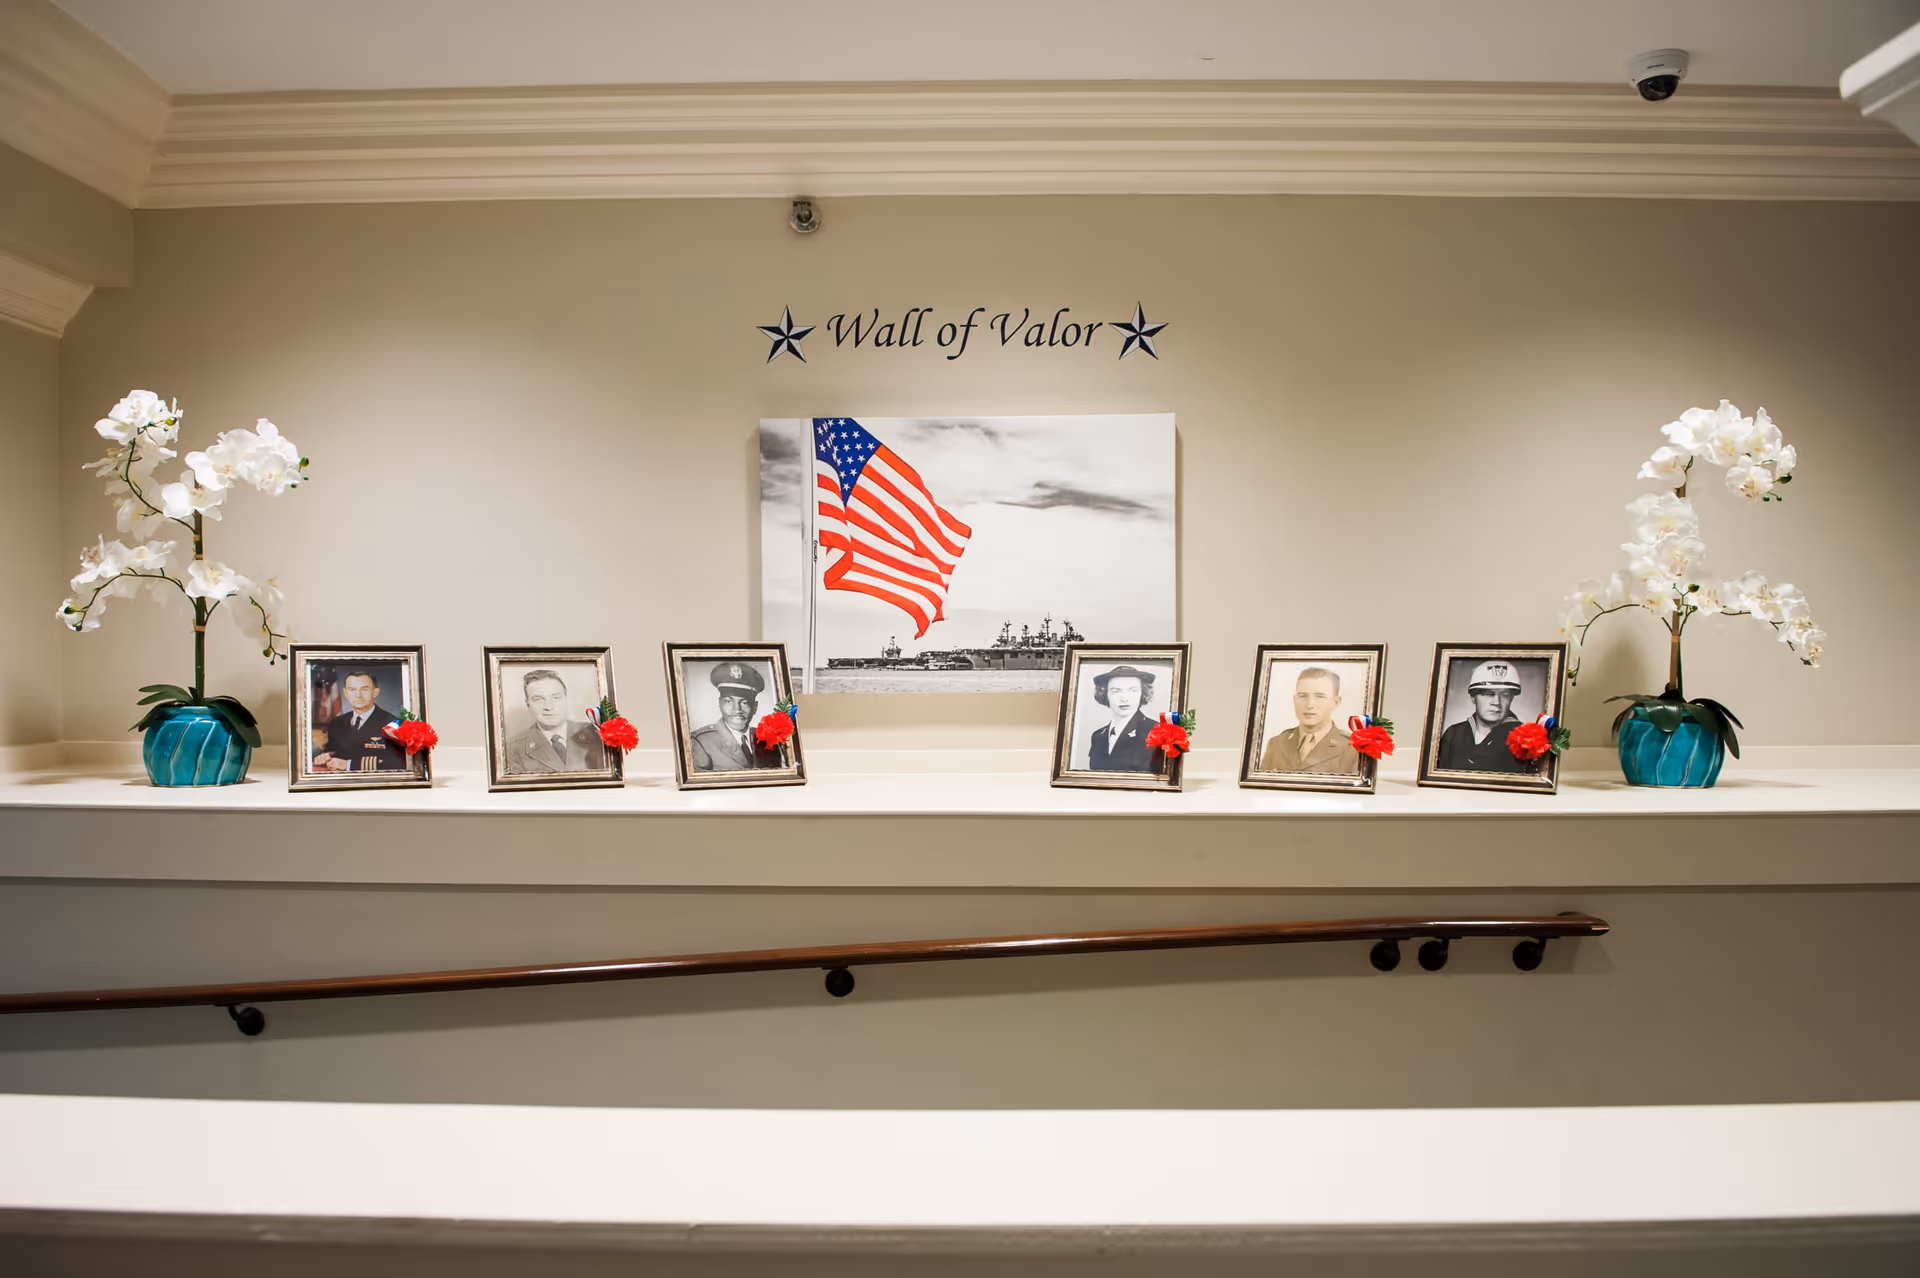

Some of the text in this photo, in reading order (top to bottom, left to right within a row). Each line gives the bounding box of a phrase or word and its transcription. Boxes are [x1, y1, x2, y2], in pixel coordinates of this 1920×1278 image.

[826, 307, 1104, 361] Wall of Valor
